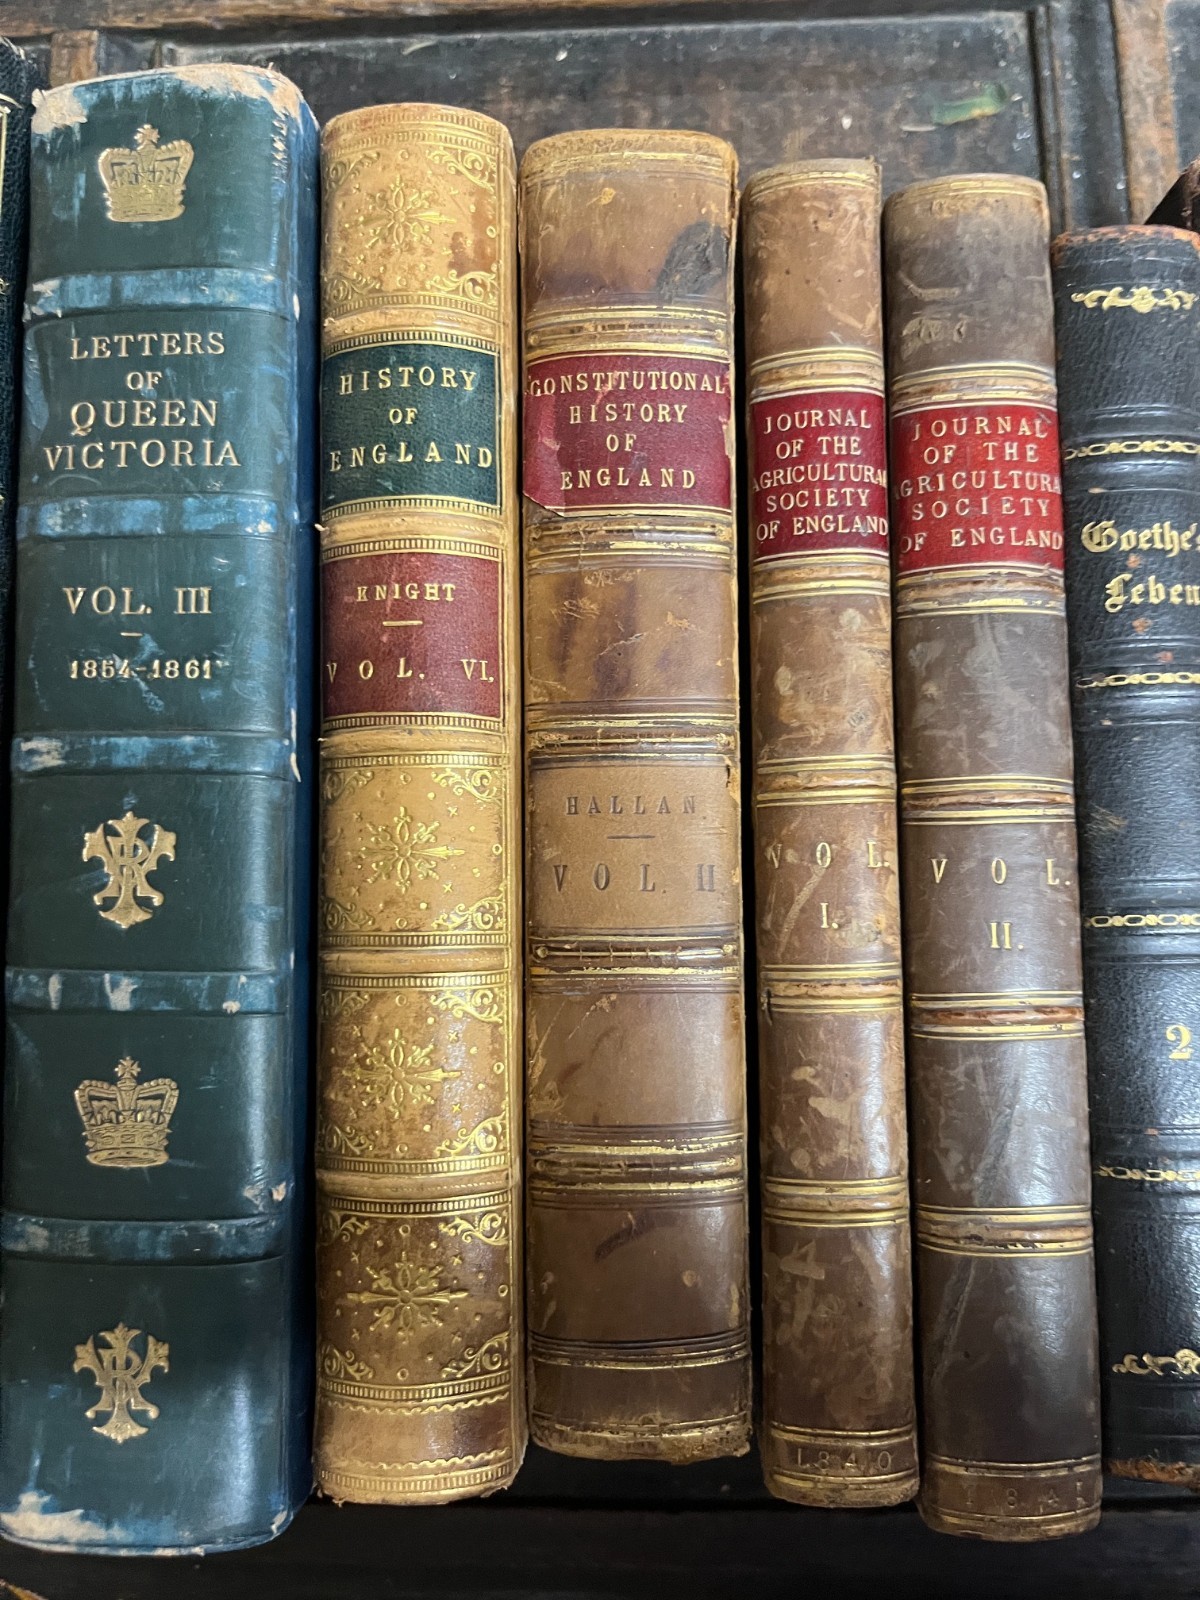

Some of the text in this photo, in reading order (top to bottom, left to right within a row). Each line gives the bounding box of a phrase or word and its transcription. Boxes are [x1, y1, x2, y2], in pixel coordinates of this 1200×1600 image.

[70, 332, 225, 360] LETTERS
[126, 371, 163, 391] OF
[338, 366, 477, 396] HISTORY
[70, 400, 219, 436] QUEEN
[388, 407, 418, 425] OF
[569, 403, 688, 424] HISTORY
[763, 408, 872, 434] JOURNAL
[911, 416, 1048, 441] JOURNAL
[43, 439, 241, 471] VICTORIA
[605, 433, 637, 452] OF
[775, 436, 862, 460] OF THE
[923, 441, 1040, 465] OF THE
[329, 442, 493, 473] ENGLAND
[560, 467, 696, 491] ENGLAND
[766, 487, 870, 512] SOCIETY
[911, 497, 1051, 521] SOCIETY
[756, 514, 888, 541] OF ENGLAND
[950, 527, 1064, 551] ENGLAND
[63, 586, 212, 615] VOL. III
[356, 583, 456, 602] KNIGHT
[69, 659, 213, 680] 1854-1861
[326, 657, 425, 684] VOL.
[765, 841, 890, 870] VOL.
[553, 863, 667, 893] VOL.
[930, 857, 1071, 885] VOL.
[819, 902, 839, 930] I.
[989, 921, 1024, 950] II.
[1165, 1024, 1194, 1060] 2
